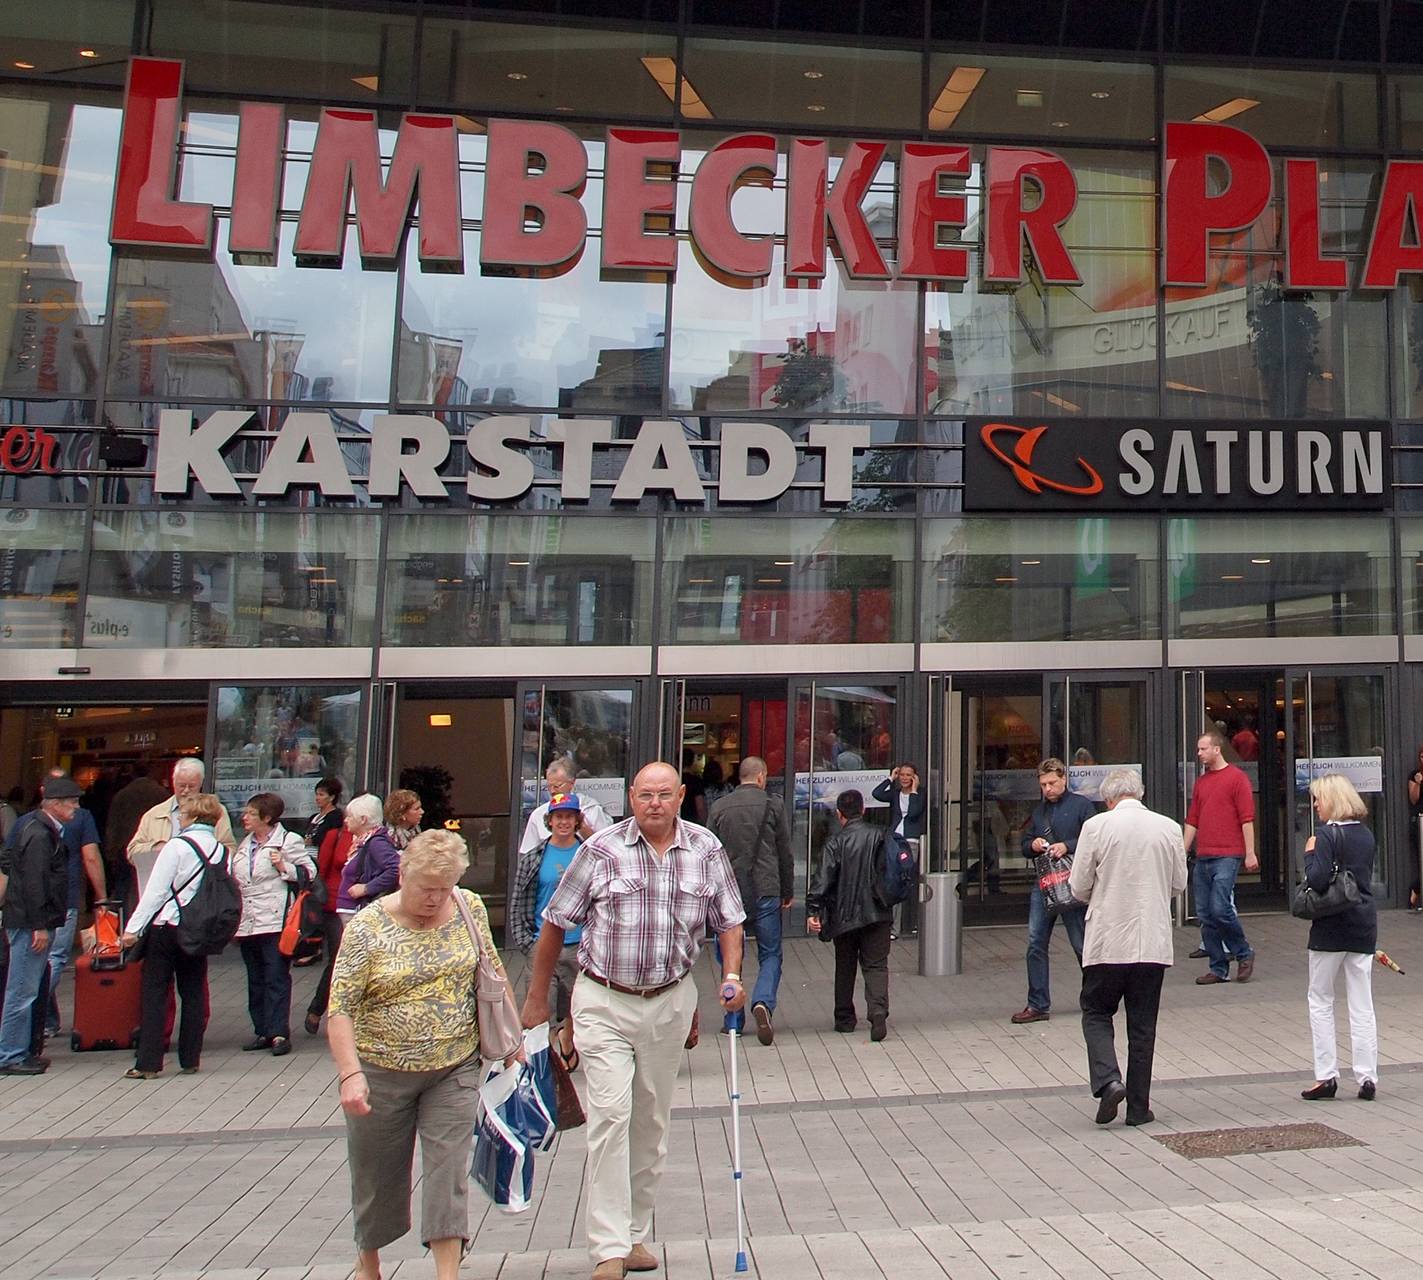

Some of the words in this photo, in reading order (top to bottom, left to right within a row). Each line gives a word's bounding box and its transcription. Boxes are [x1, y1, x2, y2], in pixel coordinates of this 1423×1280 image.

[109, 56, 1083, 288] LIMBECKER
[154, 410, 872, 507] KARSTADT
[1118, 428, 1384, 497] SATURN
